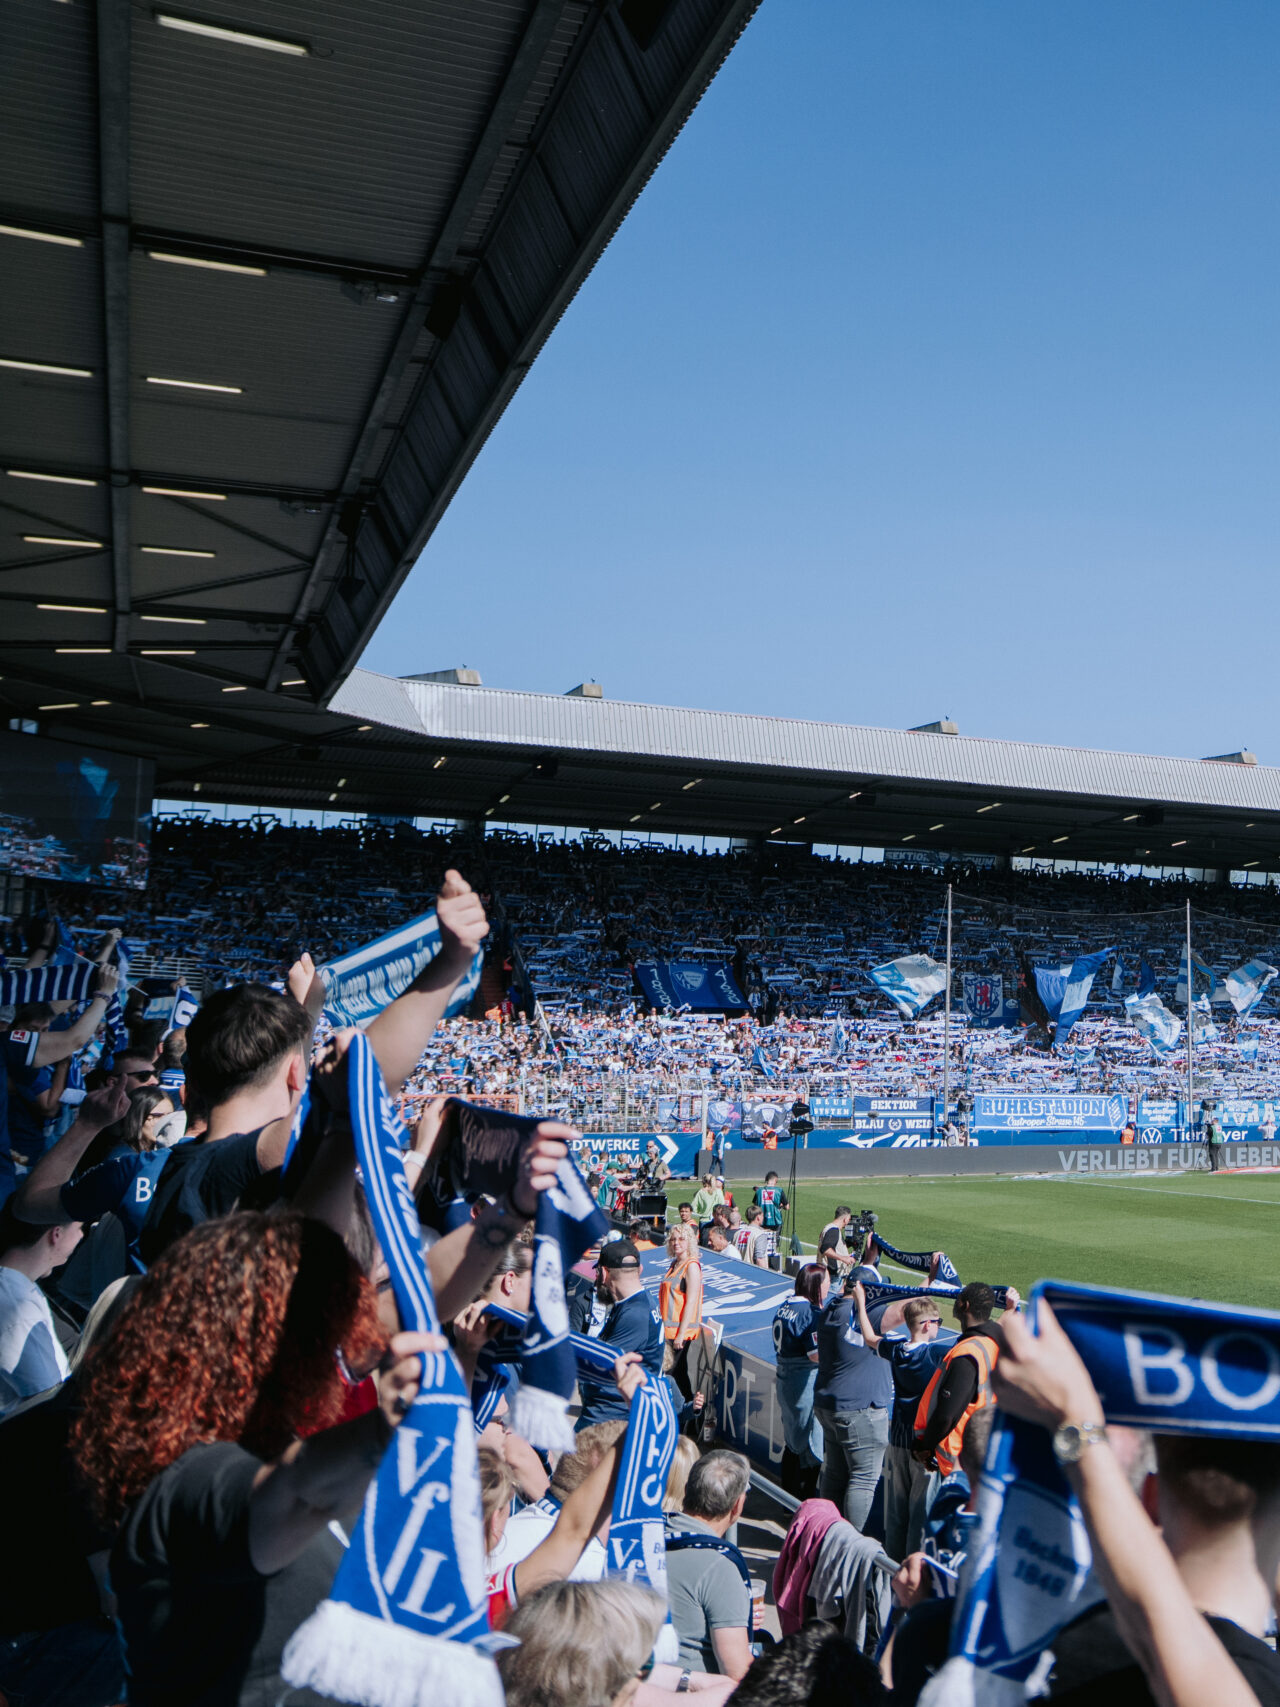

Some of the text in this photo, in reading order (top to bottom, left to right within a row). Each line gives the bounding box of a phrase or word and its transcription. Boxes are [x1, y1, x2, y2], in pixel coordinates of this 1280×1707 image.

[870, 1100, 917, 1110] SEKTION
[981, 1097, 1106, 1117] RUHRSTADION
[855, 1119, 884, 1130] BLAU
[1059, 1149, 1162, 1172] VERLIEBT
[381, 1425, 457, 1623] VfL
